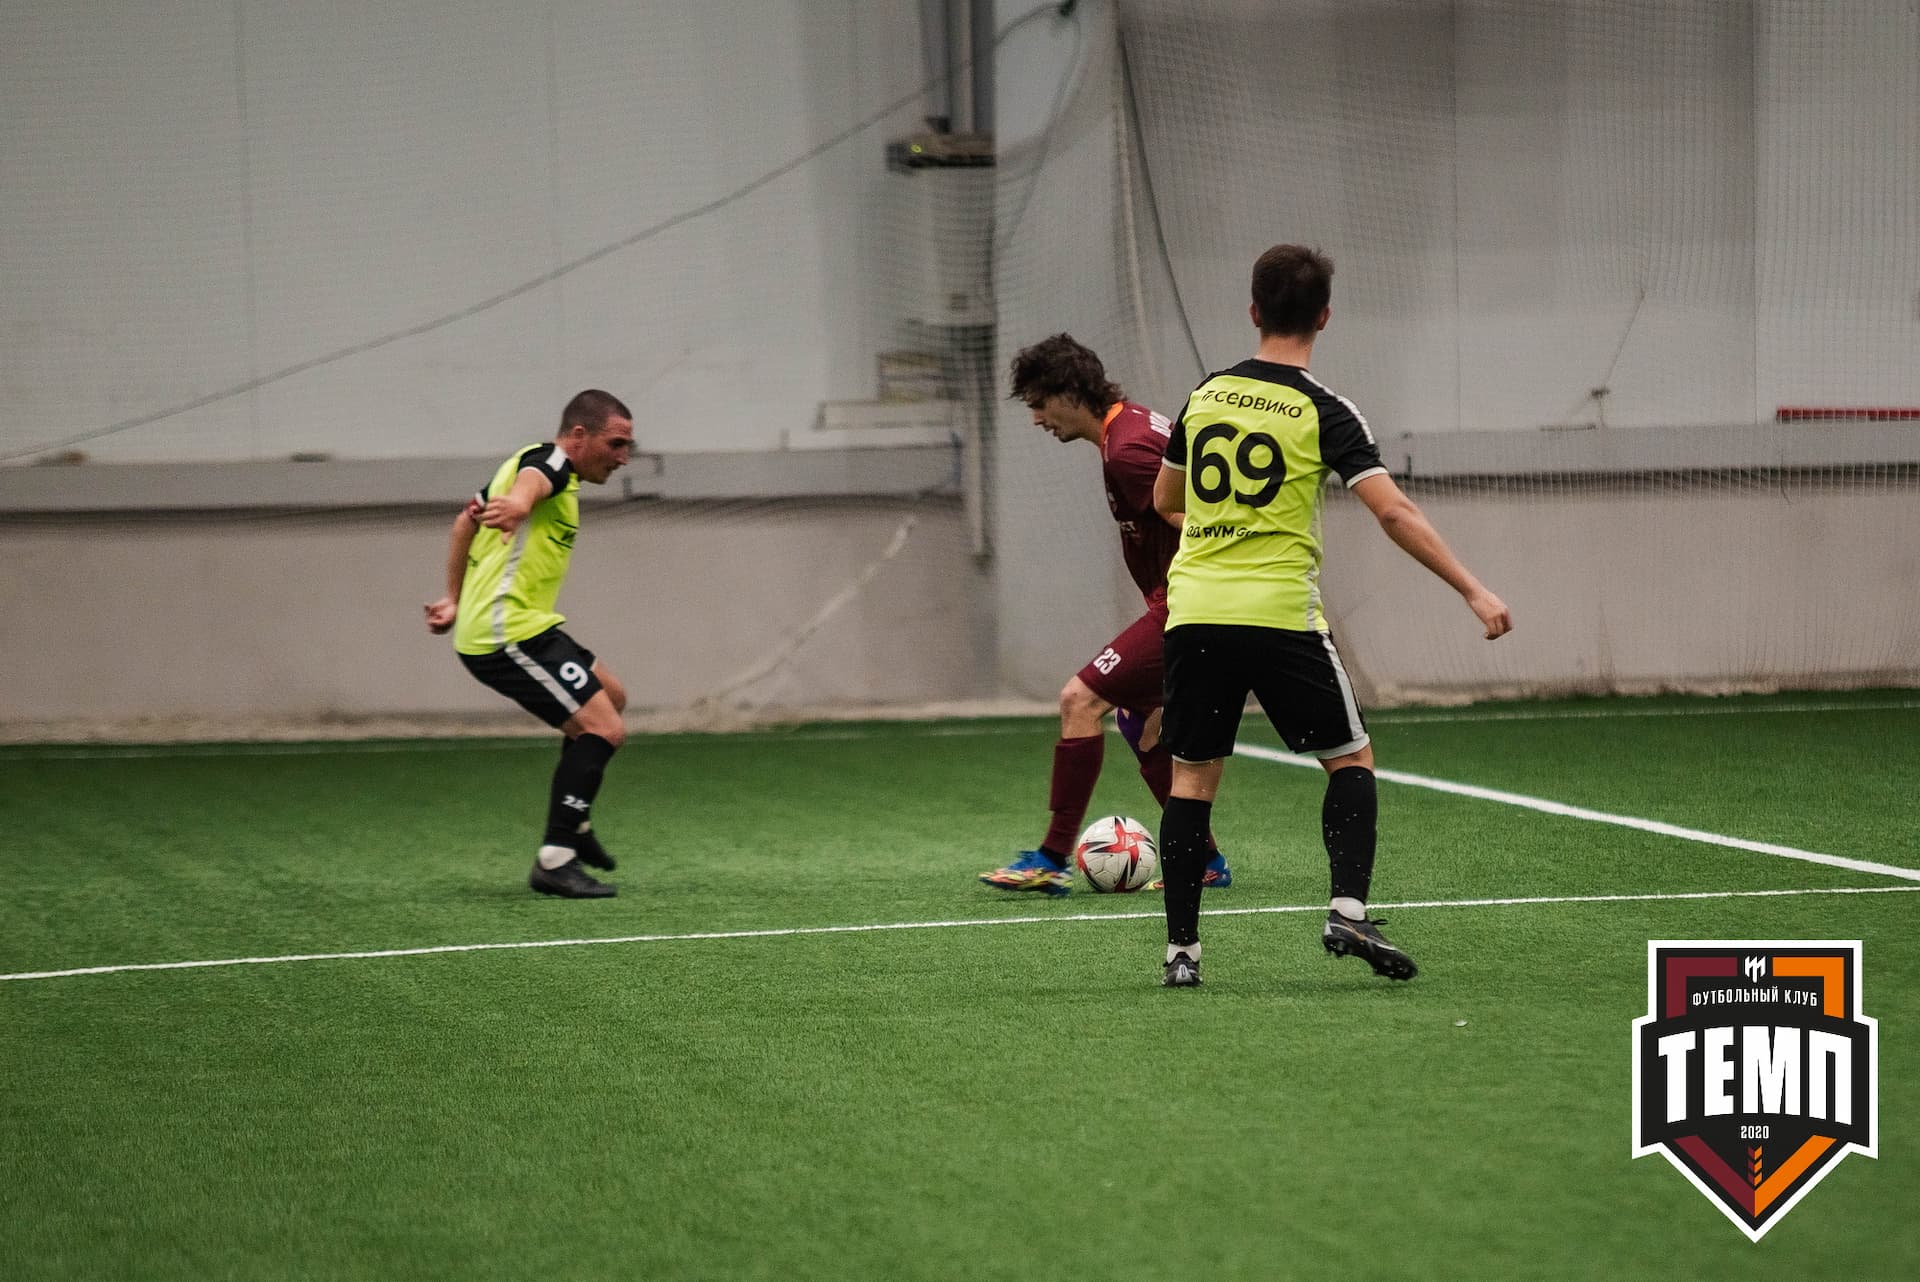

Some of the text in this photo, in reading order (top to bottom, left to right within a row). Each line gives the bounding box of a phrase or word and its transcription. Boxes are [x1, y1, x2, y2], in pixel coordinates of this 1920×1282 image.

[1191, 423, 1287, 508] 69
[1203, 525, 1235, 538] RVM
[1093, 647, 1122, 675] 23
[559, 661, 589, 690] 9
